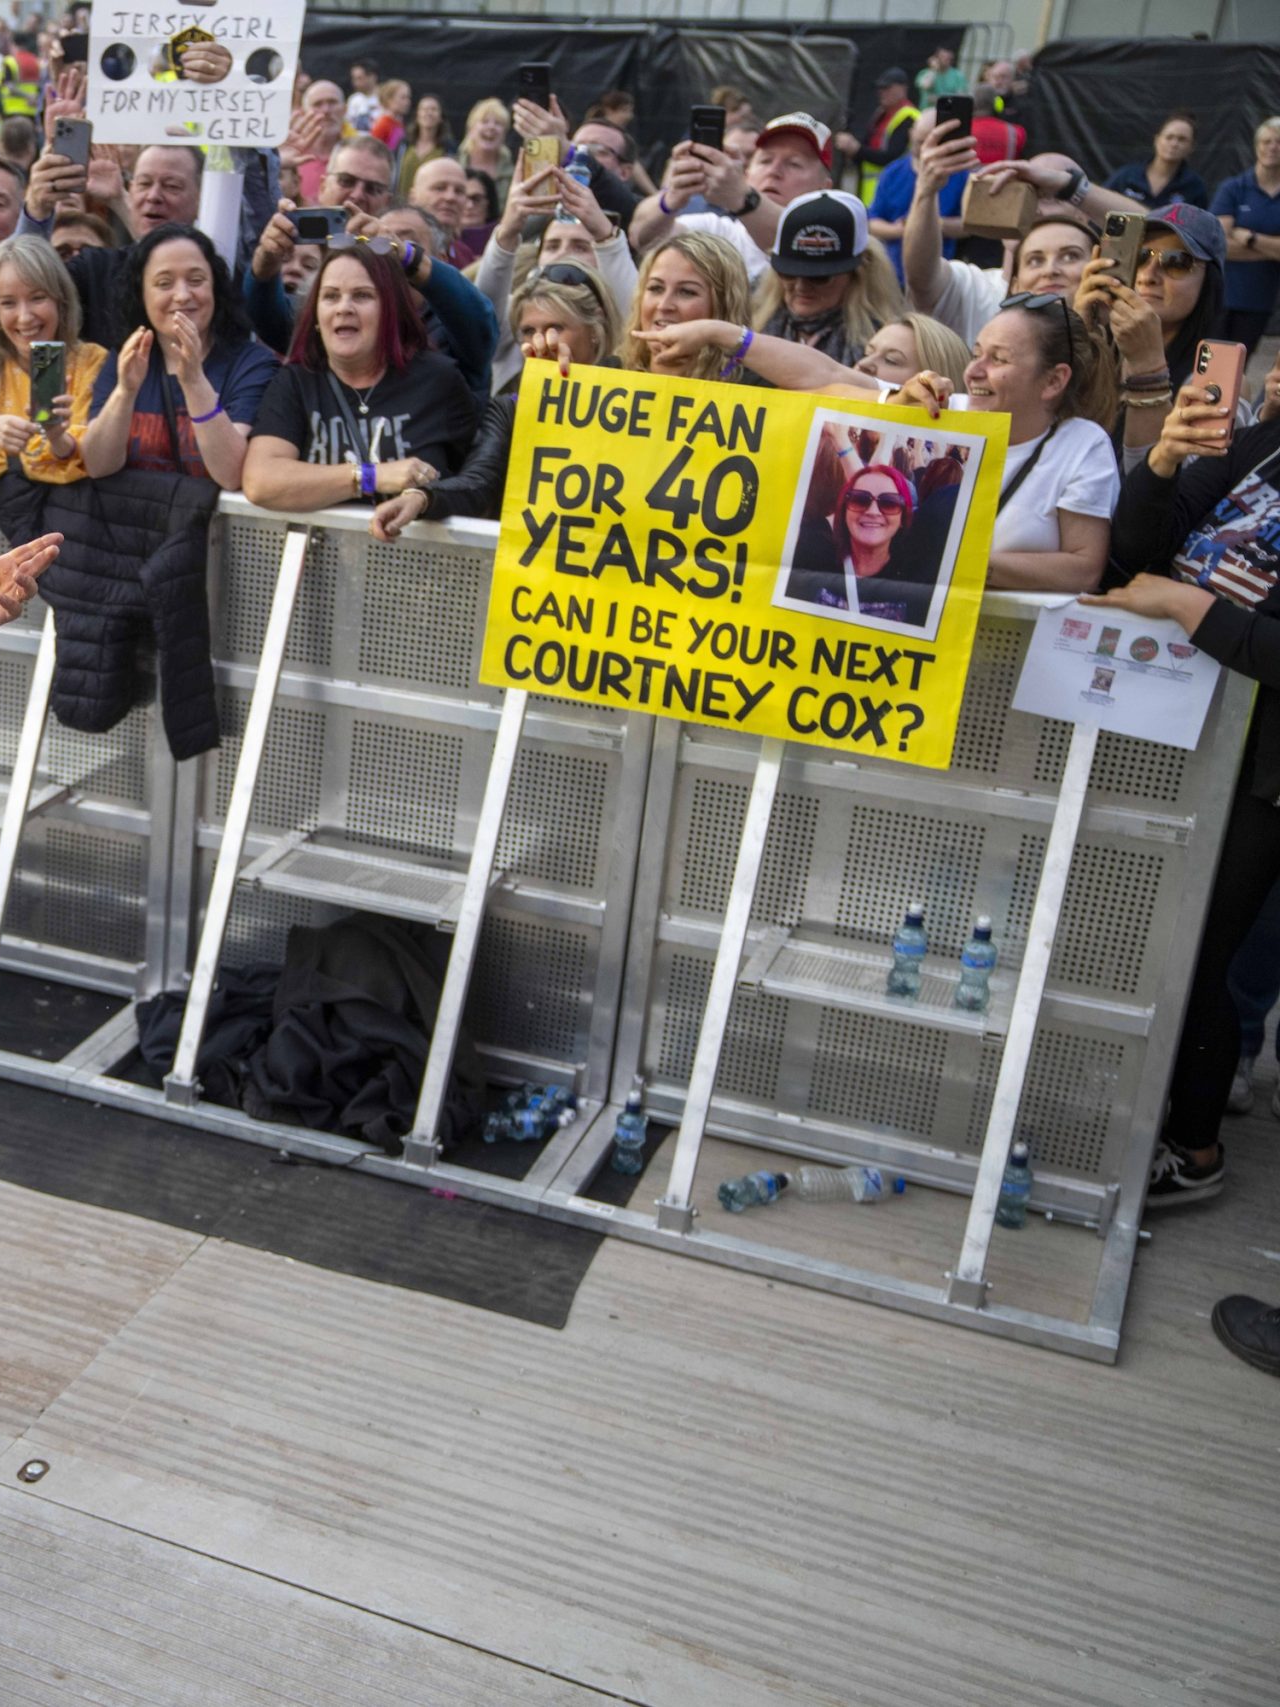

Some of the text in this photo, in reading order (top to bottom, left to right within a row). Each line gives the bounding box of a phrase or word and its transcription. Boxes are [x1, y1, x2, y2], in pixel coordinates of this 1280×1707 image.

[211, 16, 277, 39] GIRL
[100, 89, 277, 114] FOR MY JERSEY
[207, 118, 277, 140] GIRL
[537, 378, 767, 453] HUGE FAN
[528, 444, 760, 537] FOR 40
[518, 508, 748, 604] YEARS!
[511, 586, 936, 691] CAN I BE YOUR NEXT
[504, 634, 925, 752] COURTNEY COX?
